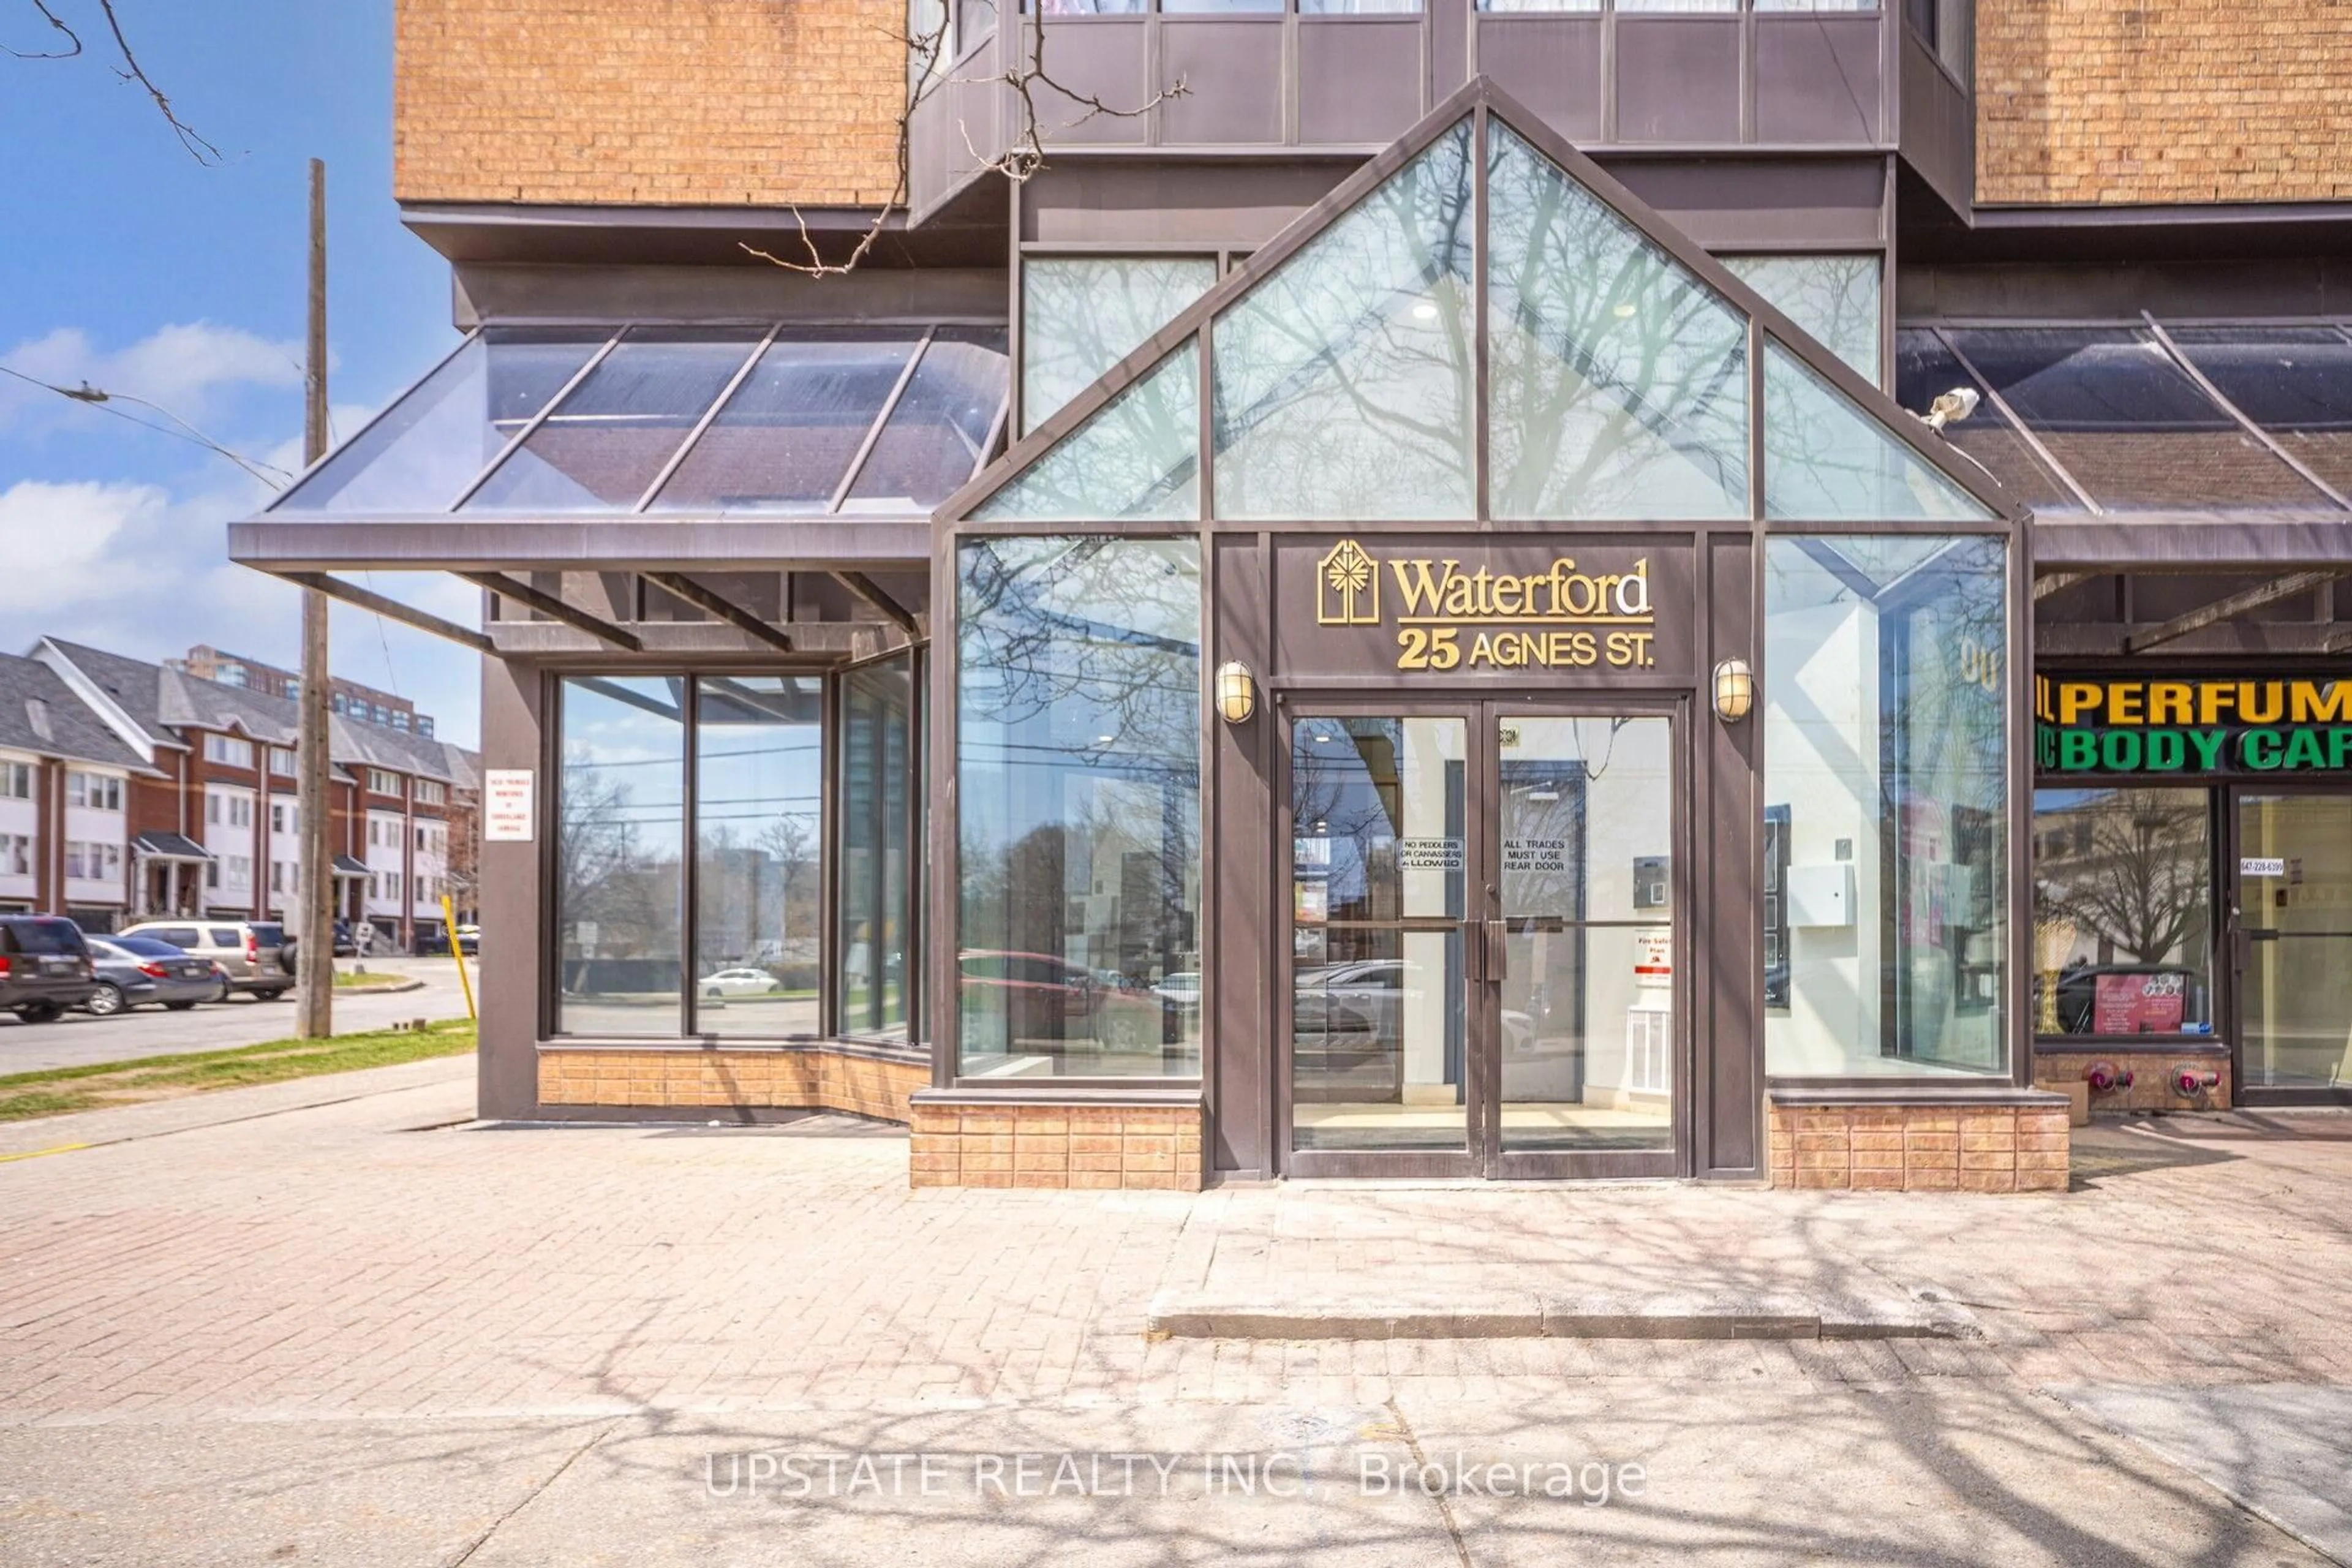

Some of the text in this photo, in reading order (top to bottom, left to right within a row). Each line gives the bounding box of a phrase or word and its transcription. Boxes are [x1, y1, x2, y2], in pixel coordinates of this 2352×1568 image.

[1389, 558, 1653, 615] Waterford
[1396, 628, 1654, 669] 25 AGNES ST.
[2060, 728, 2227, 771] BODY
[1526, 840, 1564, 849] TRADES
